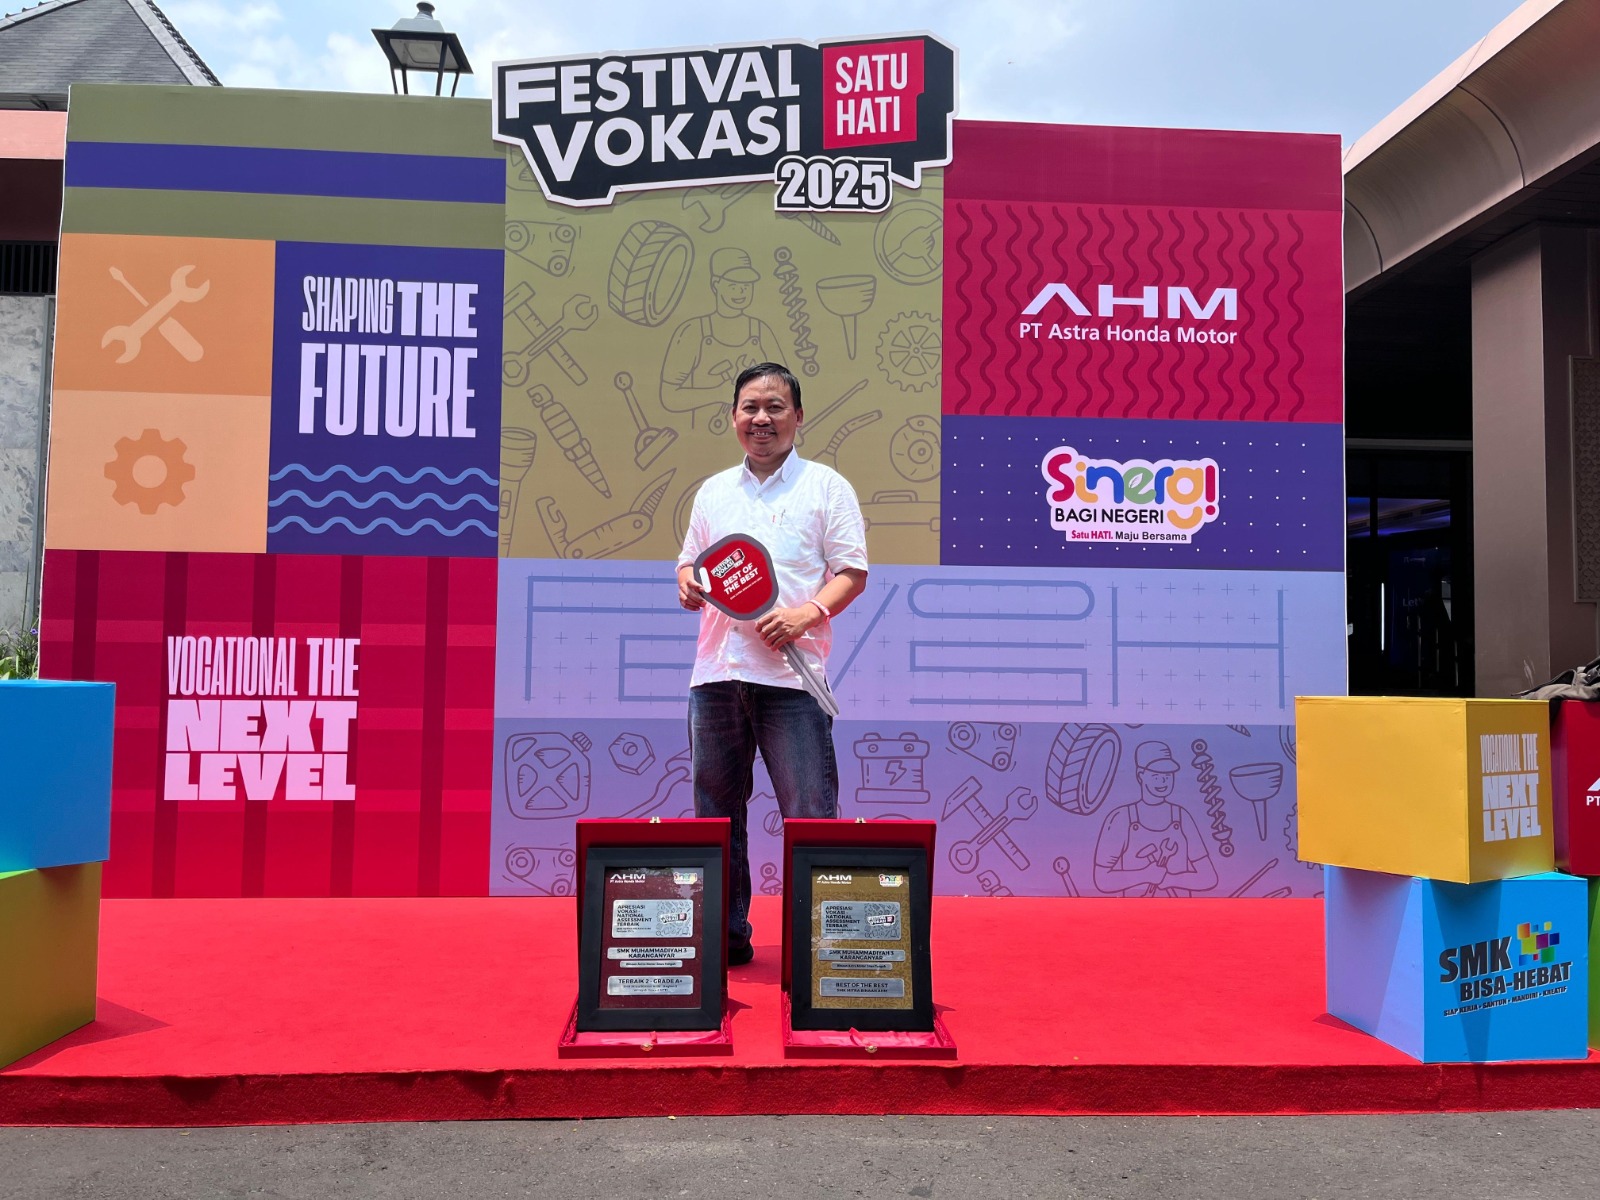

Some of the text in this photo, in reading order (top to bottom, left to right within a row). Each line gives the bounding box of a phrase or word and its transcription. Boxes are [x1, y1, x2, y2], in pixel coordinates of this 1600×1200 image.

[505, 49, 800, 118] FESTIVAL
[835, 53, 908, 94] SATU
[836, 96, 901, 136] HATI
[533, 105, 800, 182] VOKASI
[779, 161, 888, 206] 2025
[302, 275, 479, 338] SHAPING THE
[1021, 282, 1238, 320] AHM
[1019, 323, 1238, 343] PT Astra Honda Motor
[299, 342, 478, 438] FUTURE
[1055, 508, 1164, 524] BAGI NEGERI
[1071, 530, 1187, 542] Satu HATI. Maju Bersama
[722, 570, 741, 587] BEST
[742, 562, 753, 574] OF
[724, 581, 741, 595] THE
[740, 567, 759, 584] BEST
[167, 636, 361, 697] VOCATIONAL THE
[166, 699, 358, 752] NEXT
[1480, 733, 1539, 773] VOCATIONAL THE
[164, 752, 356, 801] LEVEL
[1482, 773, 1539, 811] NEXT
[1586, 795, 1600, 806] PT
[1482, 806, 1542, 842] LEVEL
[1439, 936, 1513, 984] SMK
[1443, 986, 1568, 1017] SIAP KERJA SANTUN MANDIRI KREATIF
[1460, 961, 1573, 1002] BISA-HEBAT
